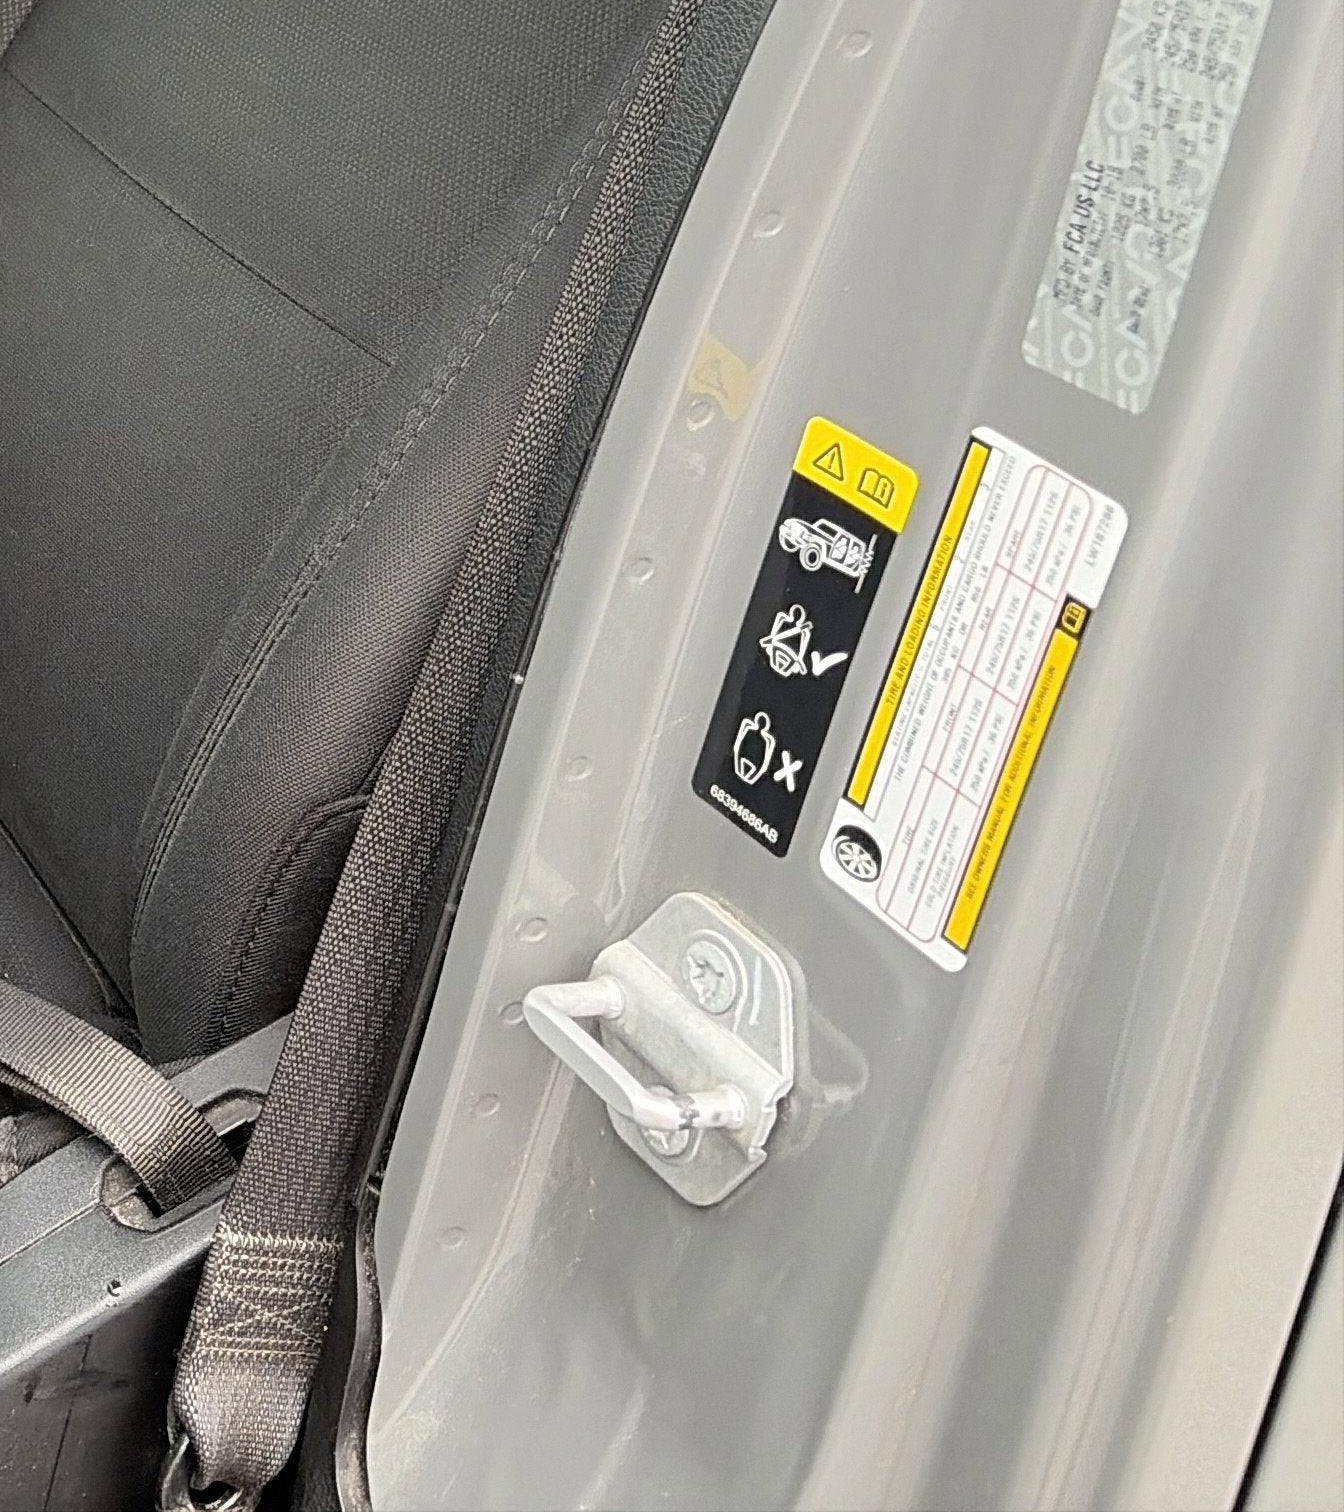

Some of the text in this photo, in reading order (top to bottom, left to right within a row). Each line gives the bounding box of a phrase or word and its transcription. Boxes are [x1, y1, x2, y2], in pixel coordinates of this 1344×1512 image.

[1072, 193, 1096, 219] US
[1078, 159, 1105, 192] LLC
[1061, 222, 1088, 255] FCA
[884, 534, 952, 705] TIRE AND LOADING INFORMATION
[894, 765, 905, 781] THE
[900, 717, 921, 763] COMBINED
[917, 682, 933, 716] WEIGHT
[934, 615, 958, 667] OCCUPANTS
[954, 593, 965, 613] AND
[961, 561, 978, 593] CARGO
[973, 523, 991, 561] SHOULD
[987, 492, 1002, 522] NEVER
[997, 455, 1016, 491] EXCEED
[901, 529, 1021, 848] TIRE FRONT REAR SPARE
[986, 806, 1004, 842] MANUAL
[999, 783, 1012, 803] FOR
[1007, 733, 1031, 782] ADDITIONAL
[1028, 664, 1056, 727] INFORMATION
[710, 784, 778, 843] 68394686AB
